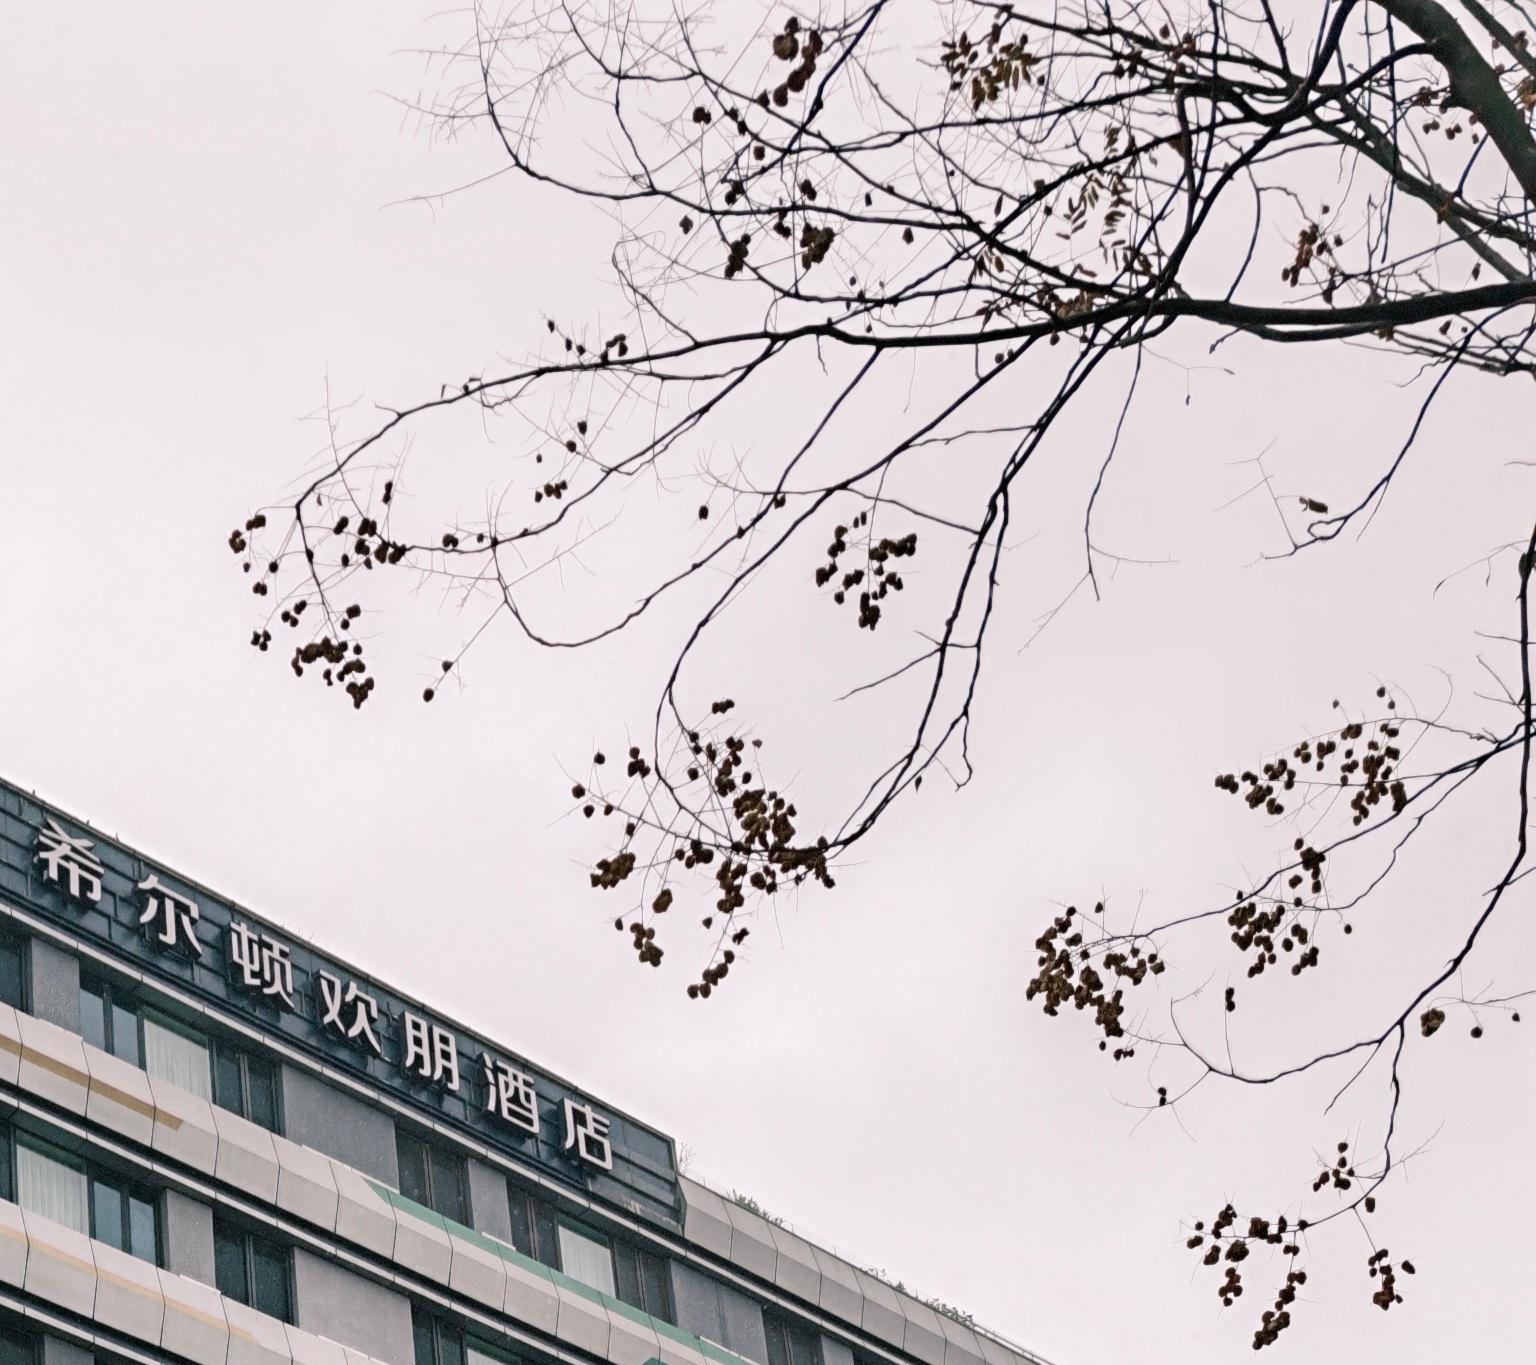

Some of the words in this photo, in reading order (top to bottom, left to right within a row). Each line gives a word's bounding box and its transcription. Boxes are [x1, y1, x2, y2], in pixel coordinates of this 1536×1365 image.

[36, 816, 613, 1172] 希尔顿欢朋酒店
